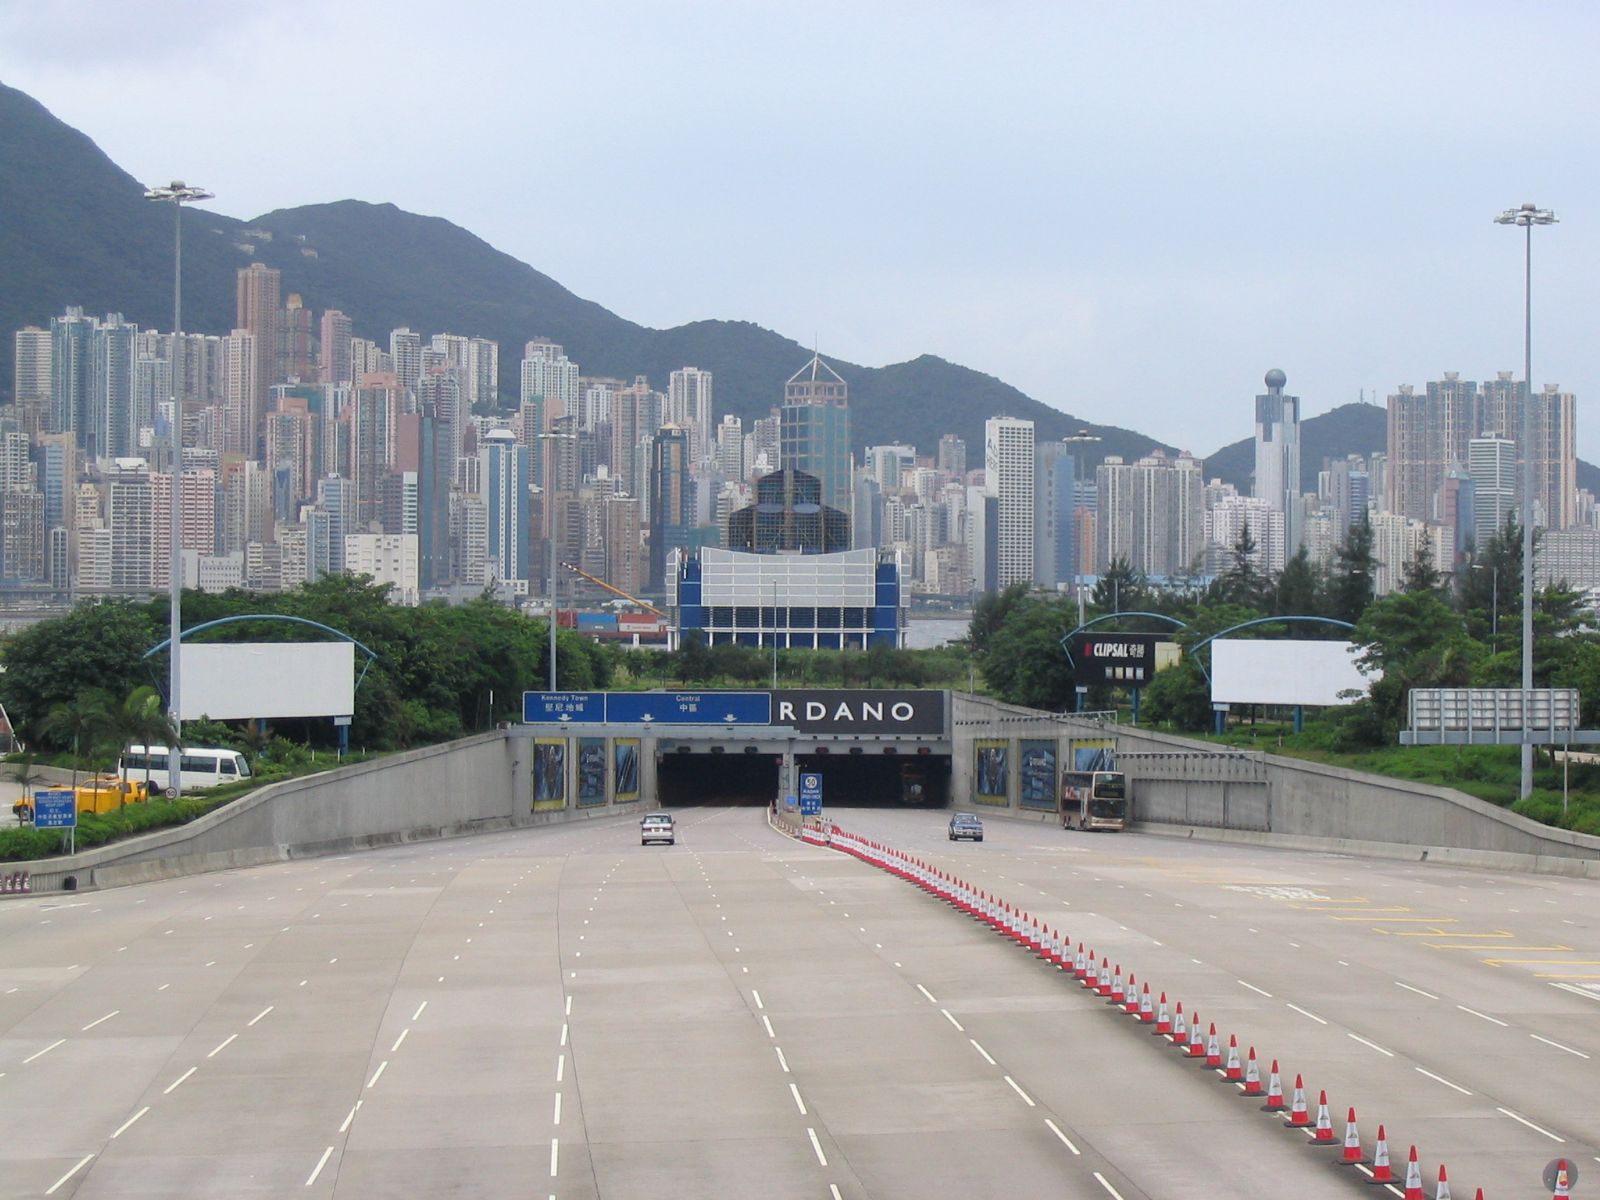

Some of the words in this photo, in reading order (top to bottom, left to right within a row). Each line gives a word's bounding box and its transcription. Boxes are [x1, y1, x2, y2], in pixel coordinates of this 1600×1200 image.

[1093, 643, 1129, 658] CLIPSAL
[541, 694, 569, 702] Kennedy
[779, 701, 914, 721] RDANO
